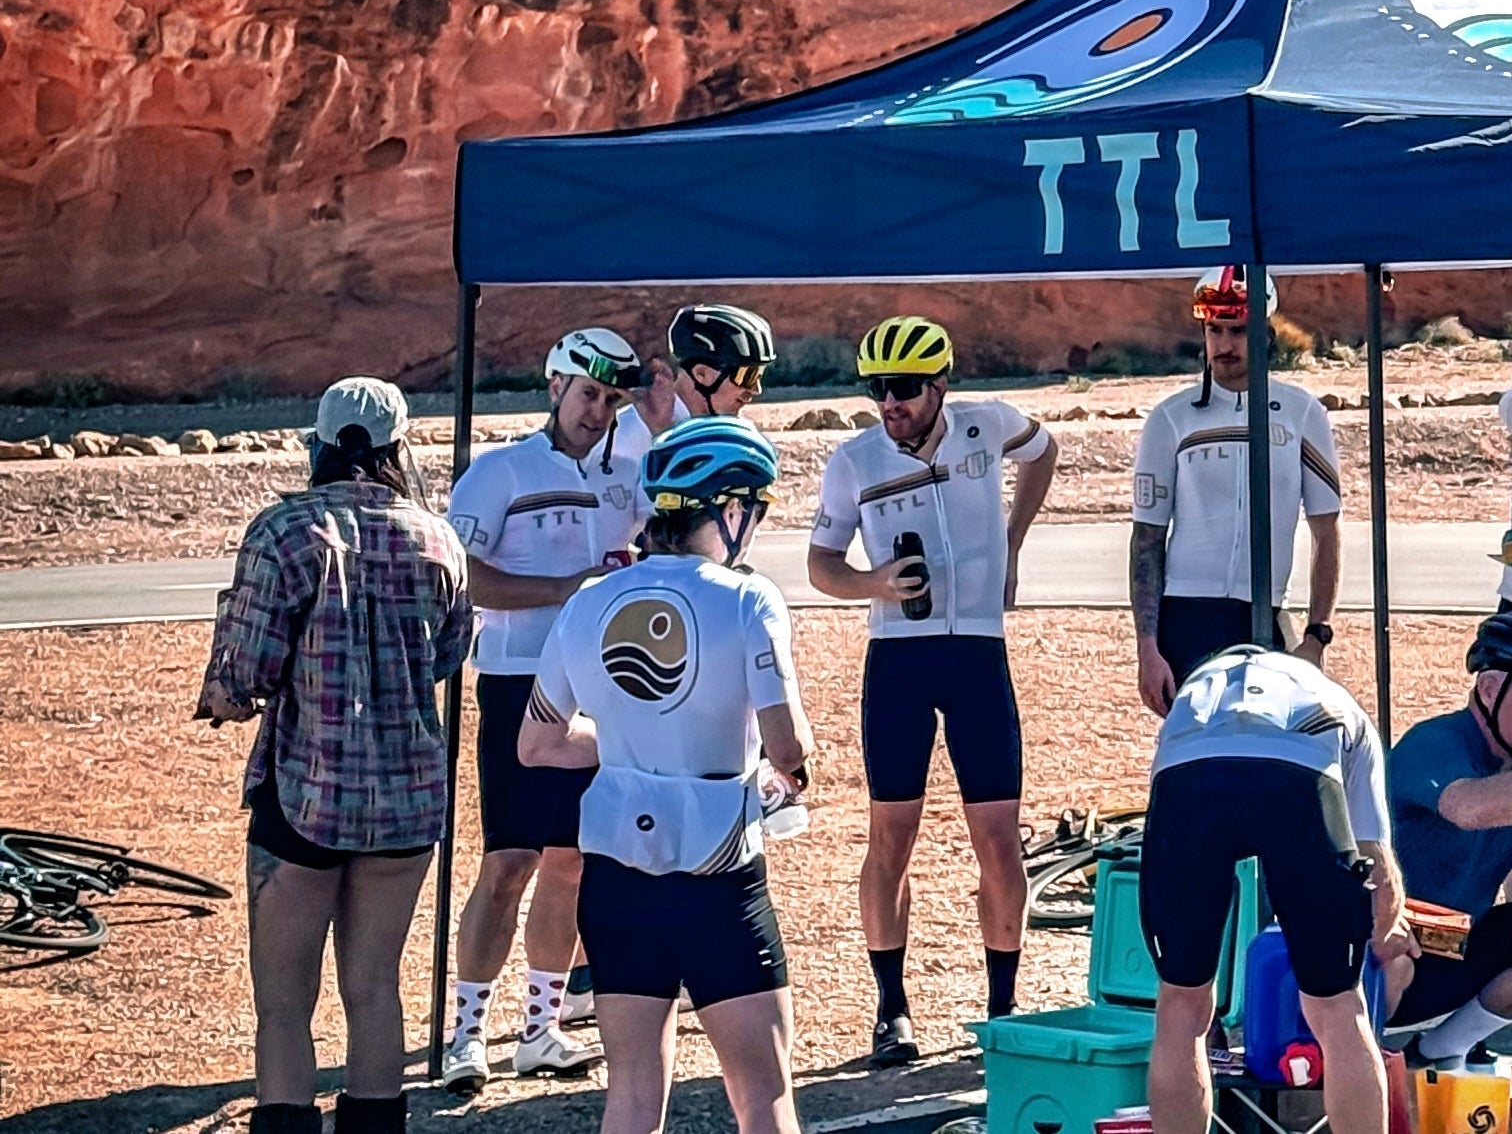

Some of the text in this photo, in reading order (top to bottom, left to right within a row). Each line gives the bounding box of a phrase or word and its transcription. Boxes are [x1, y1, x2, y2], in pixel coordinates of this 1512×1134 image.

[1022, 128, 1231, 255] TTL
[1184, 446, 1229, 464] TTL
[874, 494, 926, 516] TTL
[532, 510, 582, 529] TTL
